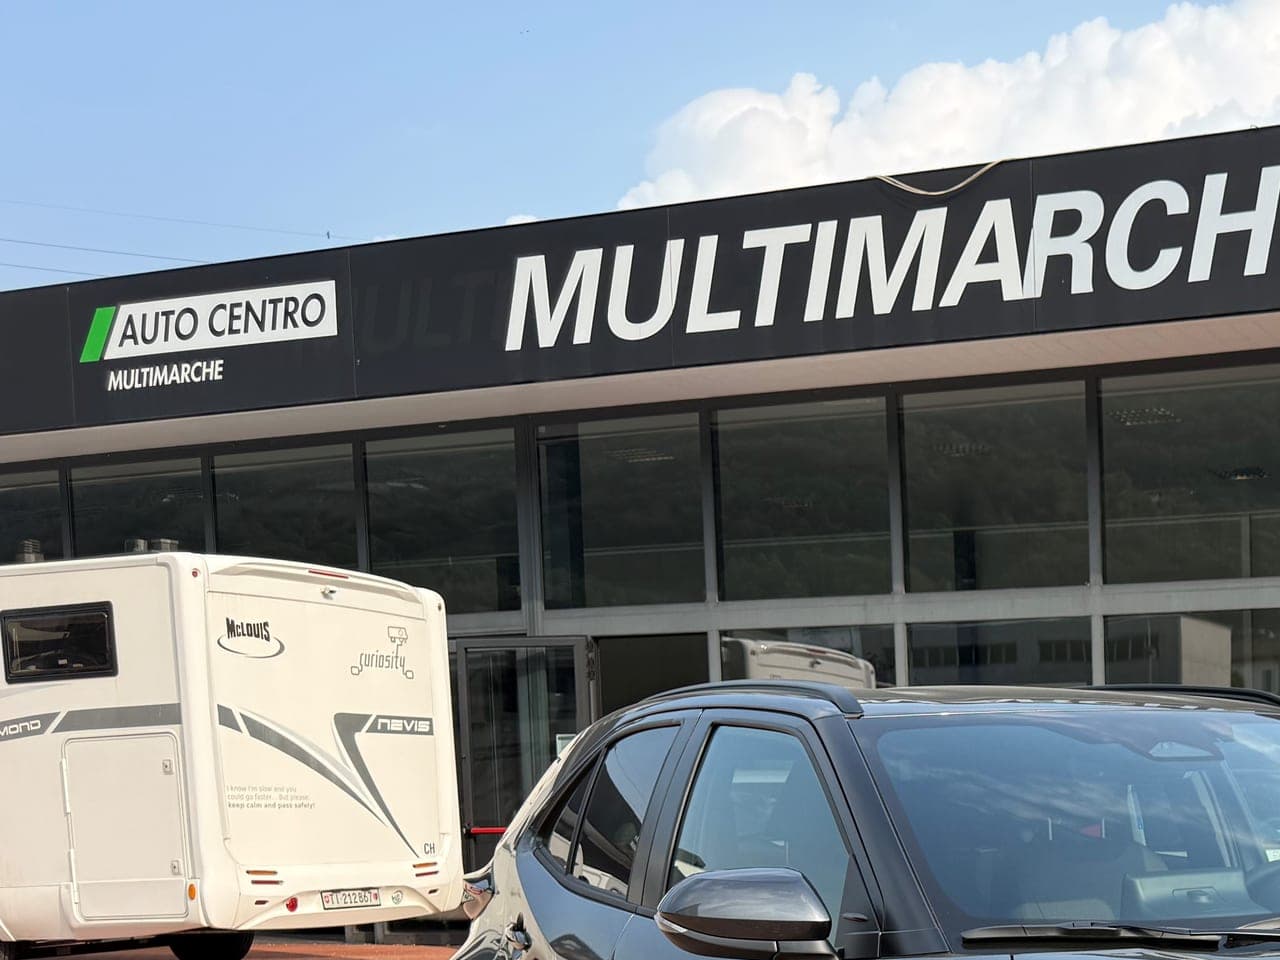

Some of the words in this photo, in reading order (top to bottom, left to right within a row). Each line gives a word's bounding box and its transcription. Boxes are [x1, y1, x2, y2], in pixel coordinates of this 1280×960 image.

[117, 305, 197, 348] AUTO
[208, 292, 327, 338] CENTRO
[107, 359, 224, 392] MULTIMARCHE
[359, 649, 406, 674] curiosity
[377, 718, 431, 732] NEVIS
[228, 802, 245, 810] keep
[423, 842, 436, 855] CH
